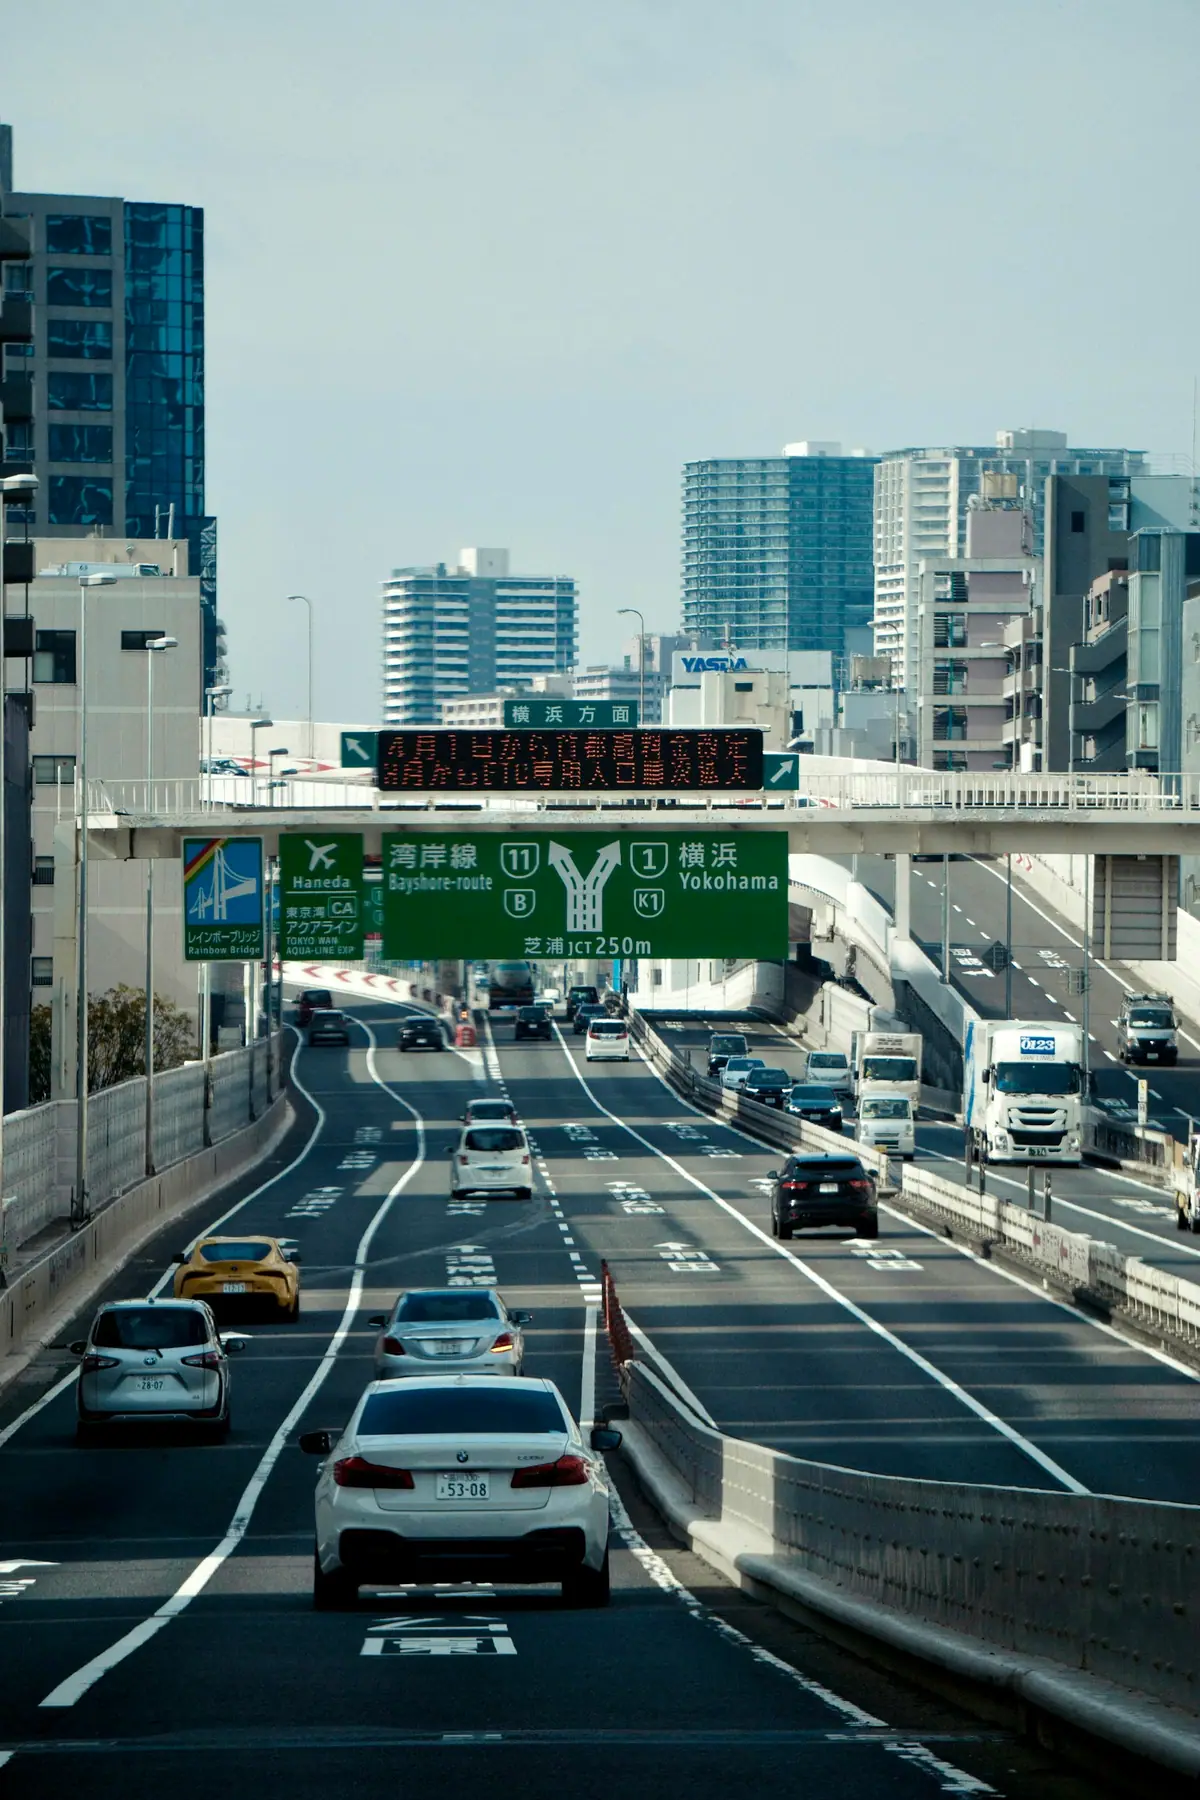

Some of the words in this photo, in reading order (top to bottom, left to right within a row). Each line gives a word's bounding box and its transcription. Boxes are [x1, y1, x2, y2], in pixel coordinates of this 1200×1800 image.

[512, 705, 629, 723] 横浜方面
[389, 842, 477, 869] 湾岸線
[508, 848, 531, 871] 11
[643, 848, 657, 870] 1
[678, 842, 738, 868] 横浜
[293, 875, 351, 888] Haneda
[389, 873, 493, 893] Bayshore-route
[679, 872, 779, 891] Yokohama
[286, 906, 326, 919] 東京湾
[331, 902, 354, 915] CA
[514, 893, 526, 911] B
[639, 893, 659, 911] K1
[286, 920, 358, 934] アクアライン
[188, 930, 260, 944] レインボーブリッジ
[286, 936, 314, 945] TOKYO
[318, 936, 339, 945] WAN
[524, 936, 564, 955] 芝浦
[568, 940, 592, 956] JCT
[595, 936, 652, 955] 250m
[188, 946, 227, 955] Rainbow
[230, 945, 260, 956] Bridge
[286, 946, 334, 956] AQUA-LINE
[1020, 1038, 1055, 1051] 0123
[659, 1251, 721, 1272] 羽田
[850, 1249, 925, 1272] 羽田
[141, 1381, 164, 1391] 28-07
[447, 1482, 487, 1497] 53-08
